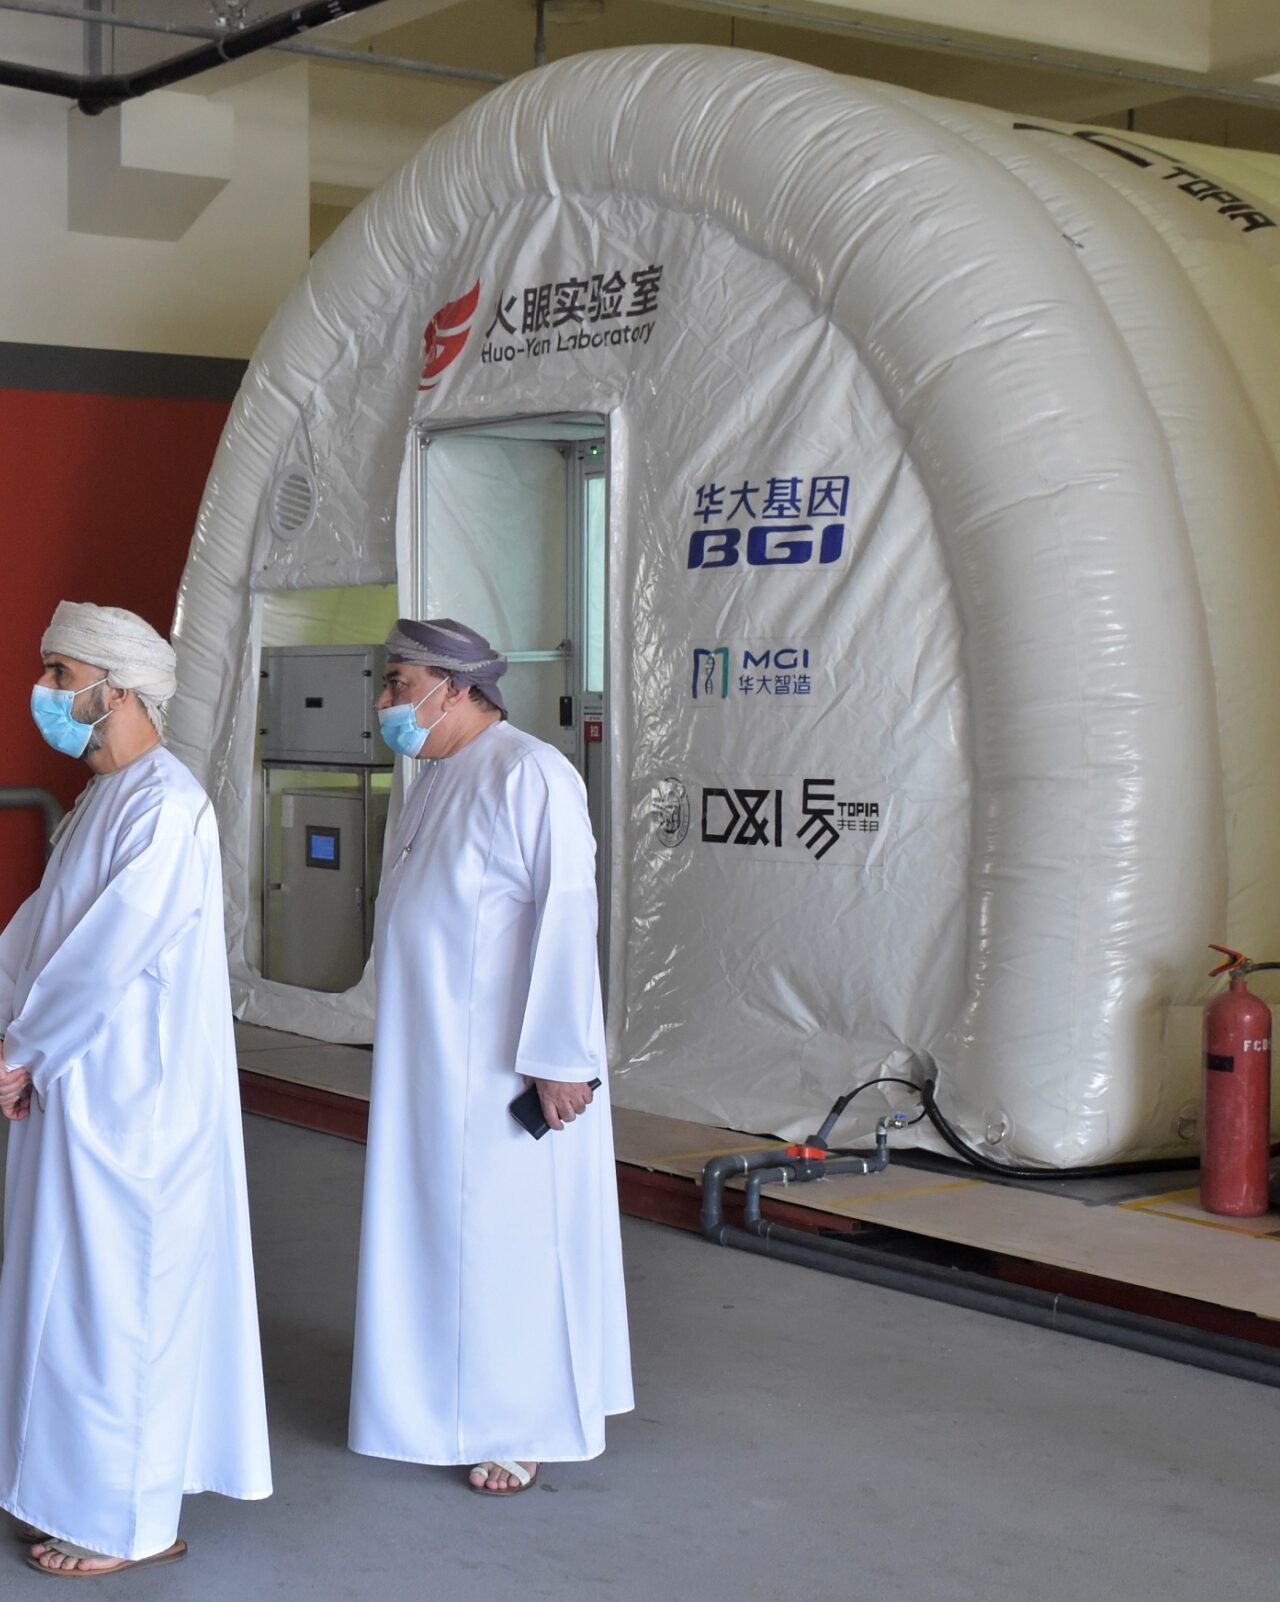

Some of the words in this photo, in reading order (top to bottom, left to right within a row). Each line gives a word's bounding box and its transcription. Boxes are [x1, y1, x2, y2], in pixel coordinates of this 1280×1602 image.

[1161, 165, 1277, 233] TOPIA
[485, 264, 664, 338] 火眼实验室
[481, 337, 551, 364] Huo-Yan
[556, 320, 656, 352] Laboratory
[693, 475, 851, 524] 华大基因
[687, 523, 845, 570] BGI
[742, 648, 809, 669] MGI
[738, 674, 811, 696] 华大智造
[837, 802, 880, 817] TOPIA
